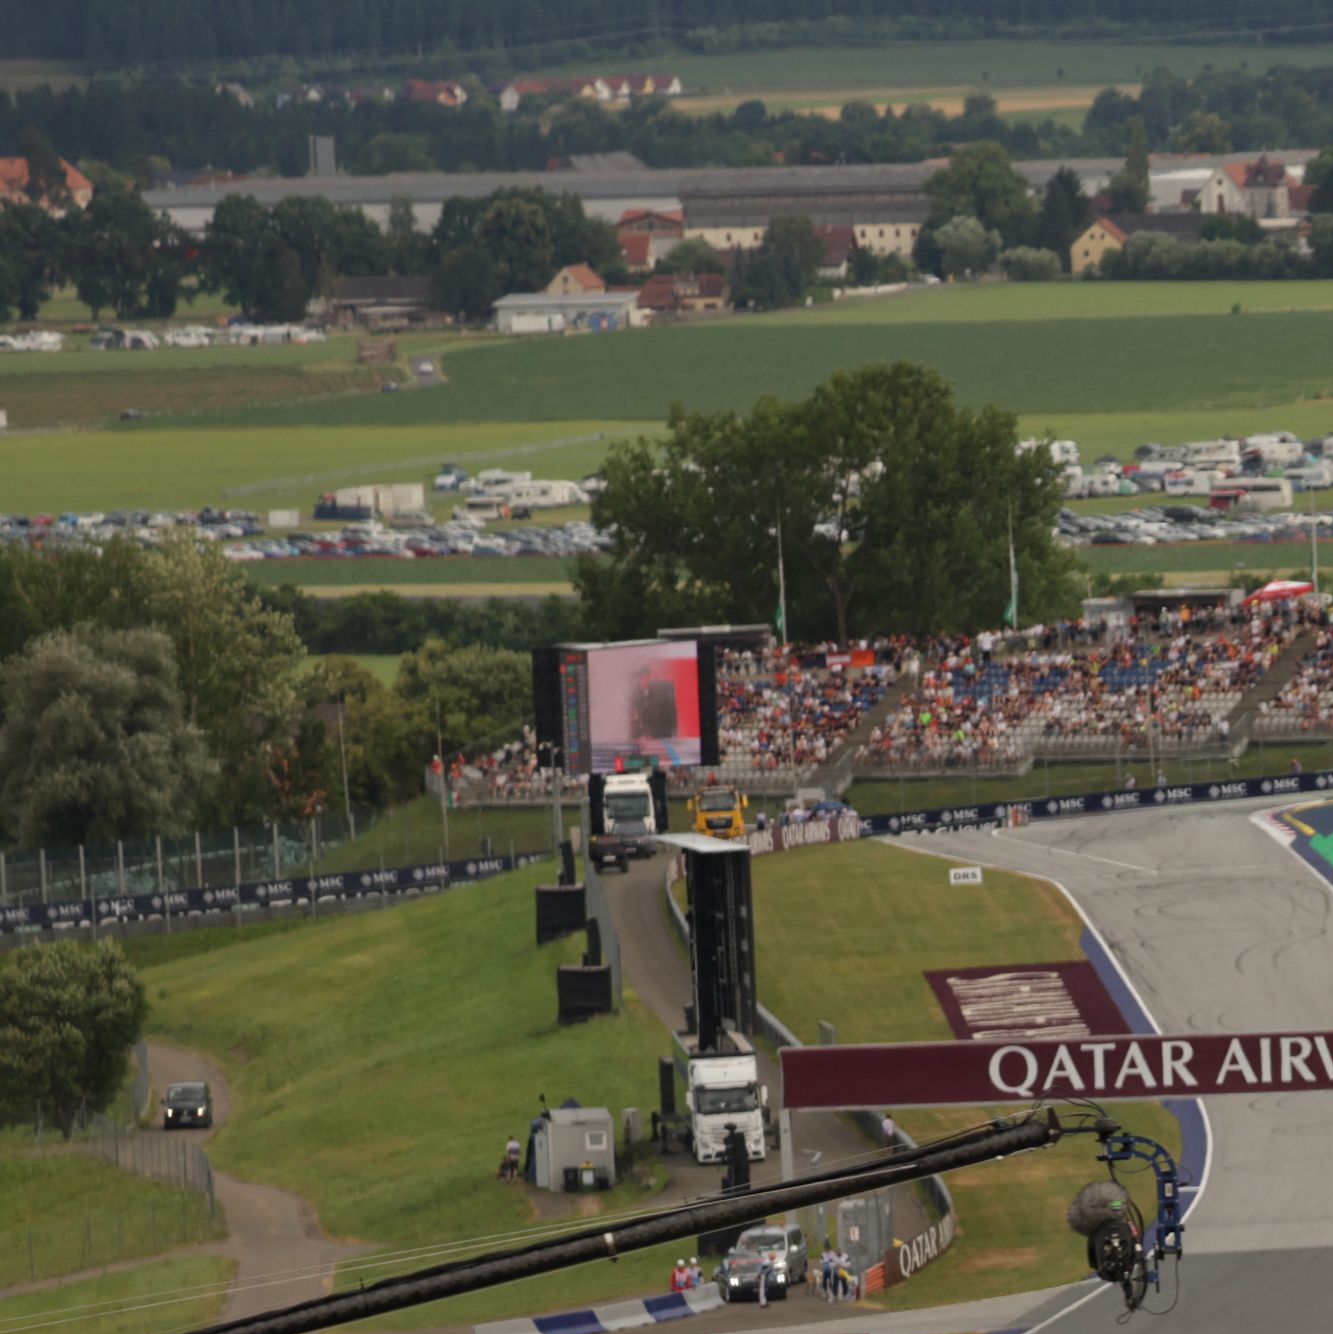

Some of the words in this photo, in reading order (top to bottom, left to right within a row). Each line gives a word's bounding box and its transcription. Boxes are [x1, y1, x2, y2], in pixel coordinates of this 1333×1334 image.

[1221, 782, 1246, 794] MSC
[1274, 778, 1299, 789] MSC
[1167, 787, 1192, 798] MSC
[1060, 799, 1085, 809] MSC
[1115, 793, 1140, 804] MSC
[953, 808, 978, 819] MSC
[479, 860, 503, 871] MSC
[268, 881, 292, 894] MSC
[319, 877, 344, 889] MSC
[988, 1040, 1199, 1098] QATAR
[899, 1226, 938, 1278] QATAR
